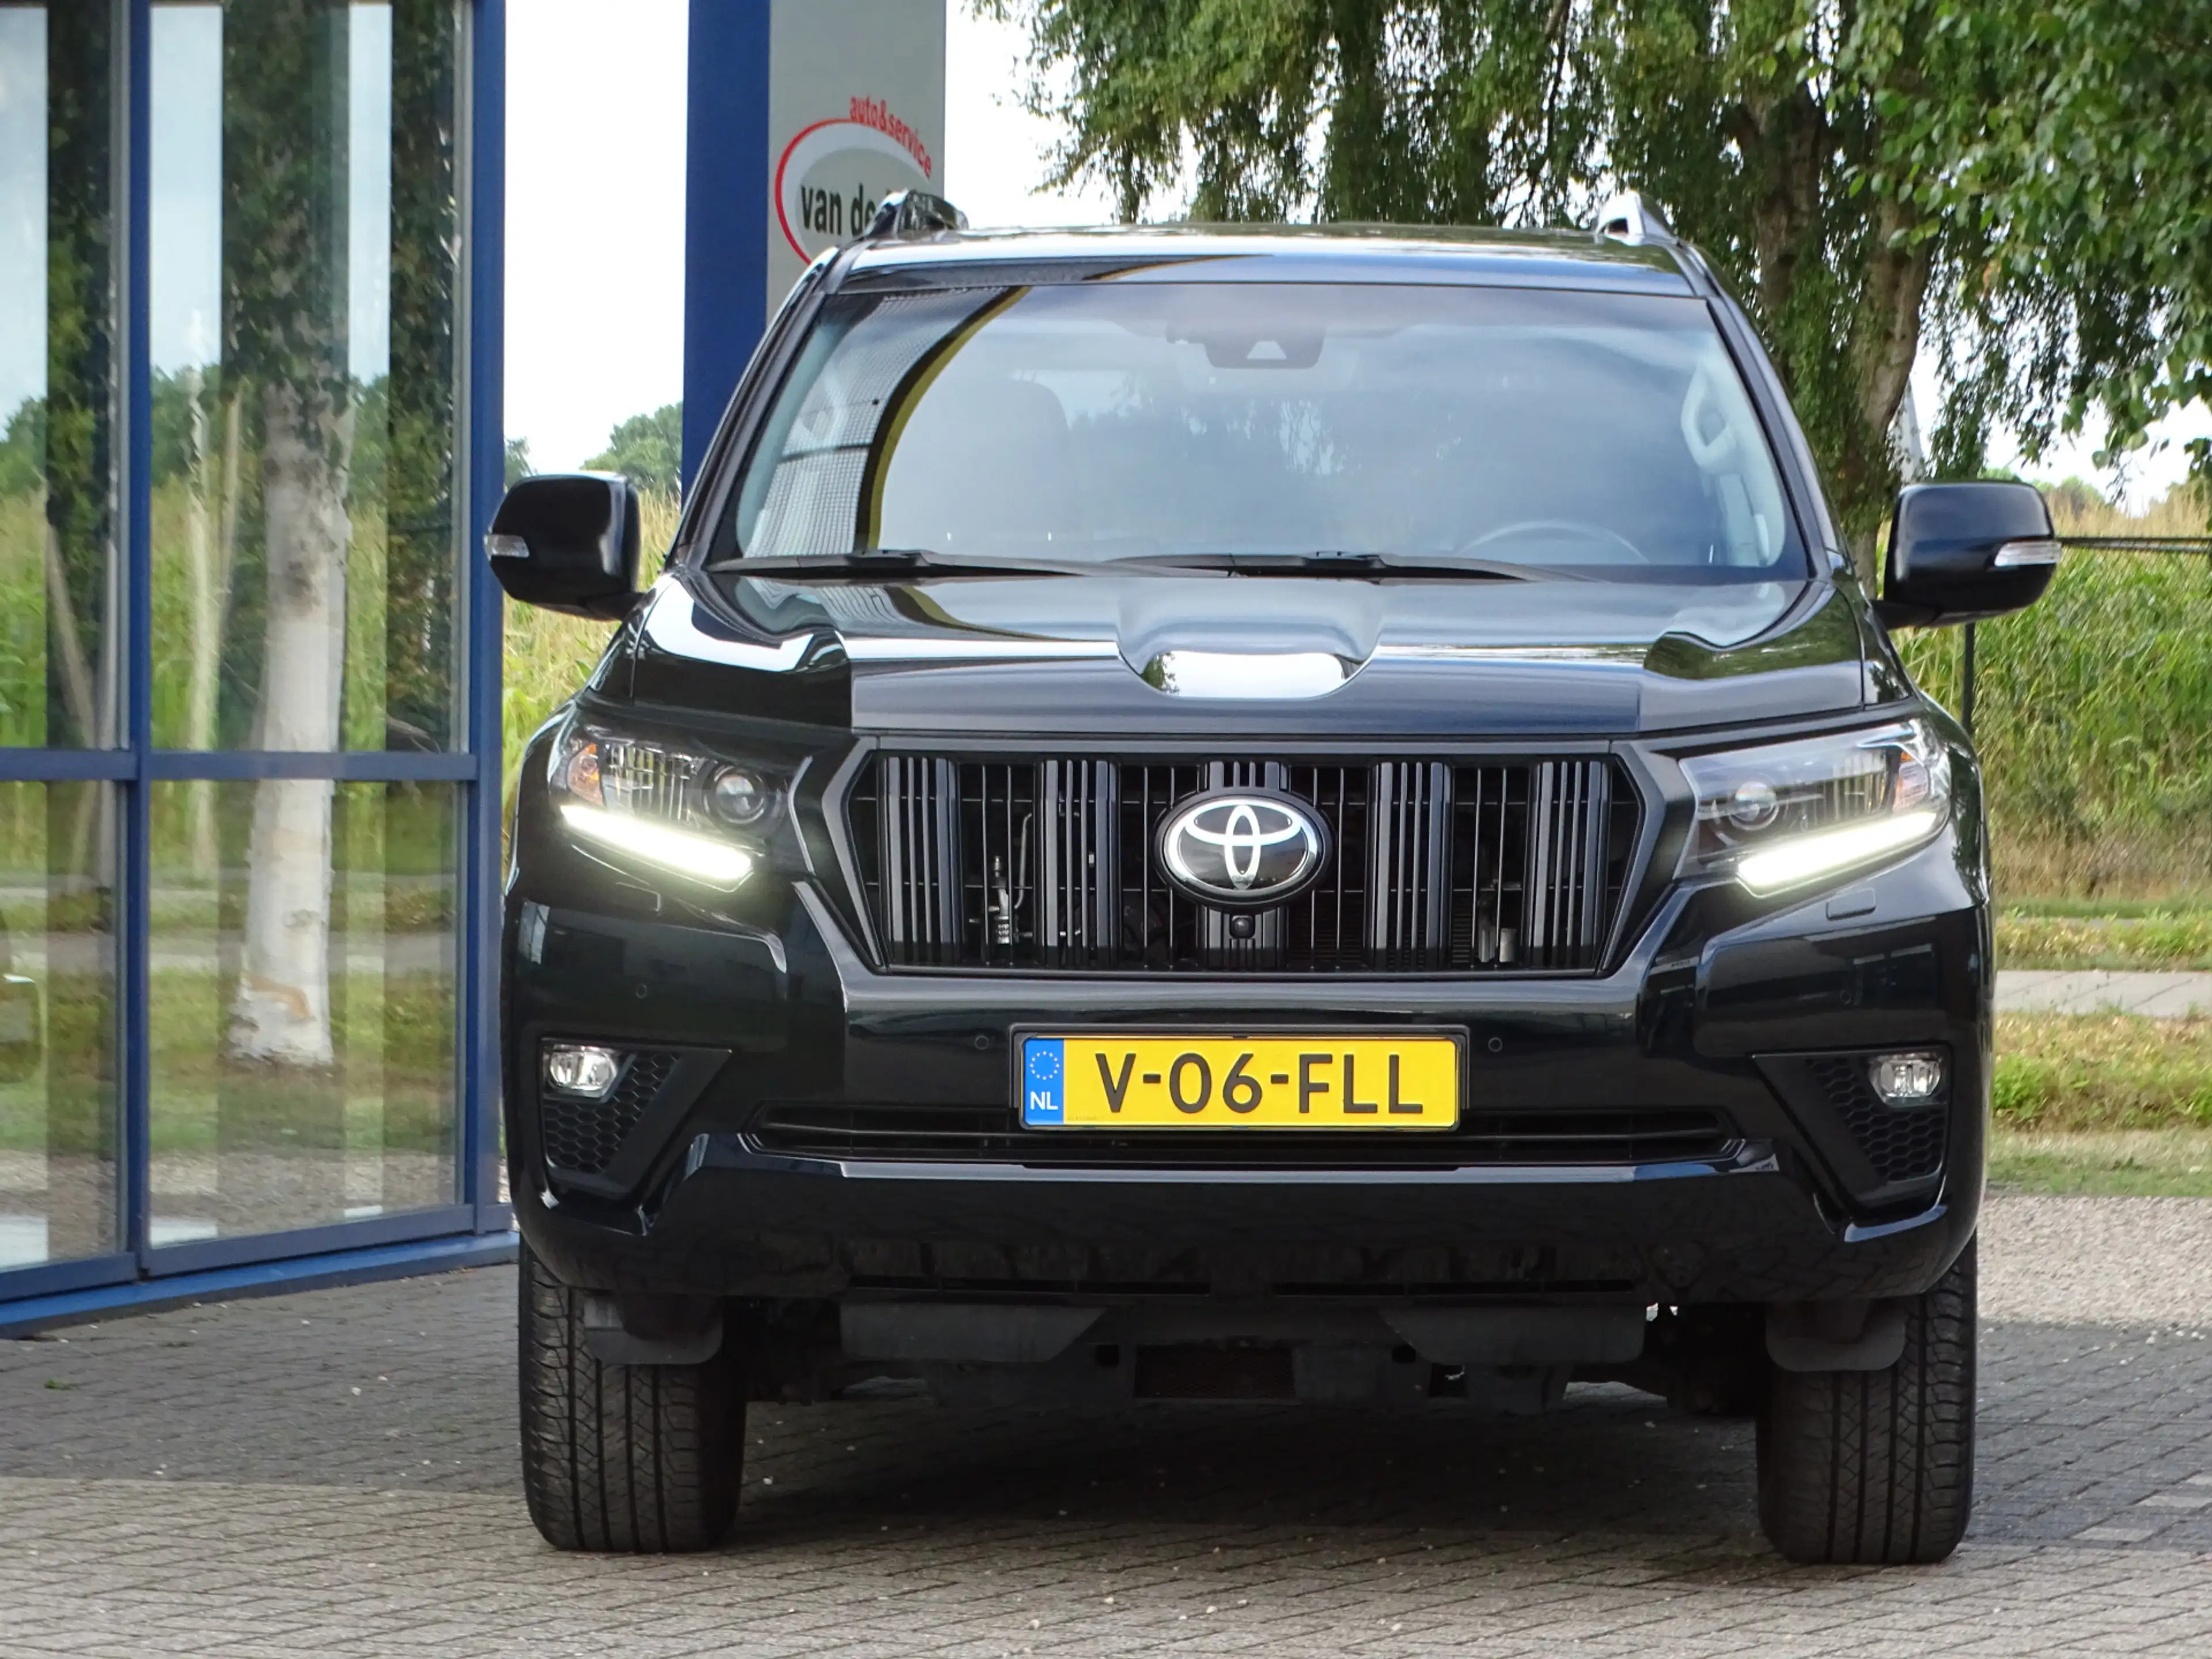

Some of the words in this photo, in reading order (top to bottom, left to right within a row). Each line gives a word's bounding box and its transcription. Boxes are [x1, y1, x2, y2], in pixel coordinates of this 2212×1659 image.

[850, 96, 931, 180] auto&service
[800, 184, 842, 237] van
[1030, 1091, 1059, 1111] NL
[1094, 1052, 1423, 1114] V-06-FLL
